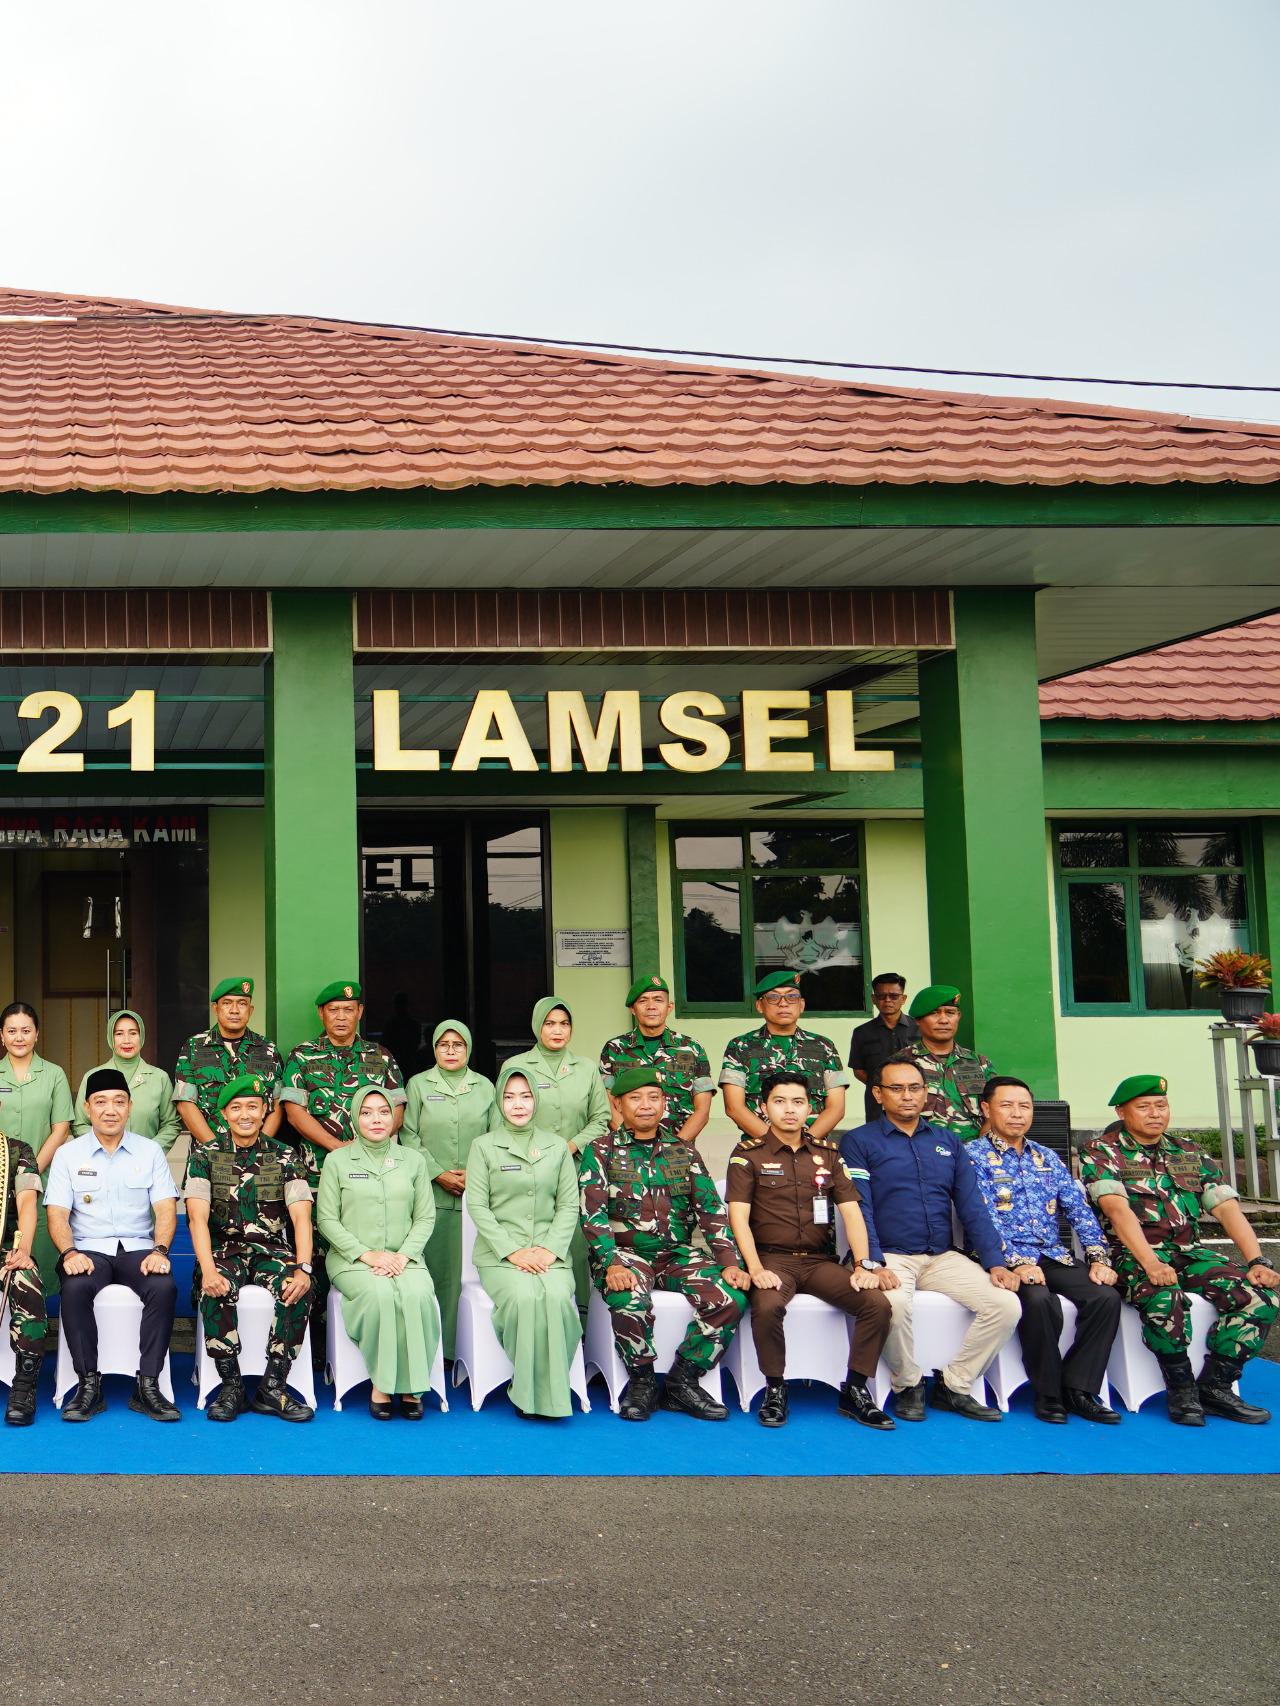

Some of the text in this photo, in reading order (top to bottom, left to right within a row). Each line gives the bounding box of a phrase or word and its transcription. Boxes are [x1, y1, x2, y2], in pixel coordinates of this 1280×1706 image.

[372, 689, 895, 772] LAMSEL
[52, 816, 124, 843] RAGA
[132, 816, 197, 843] KAMI
